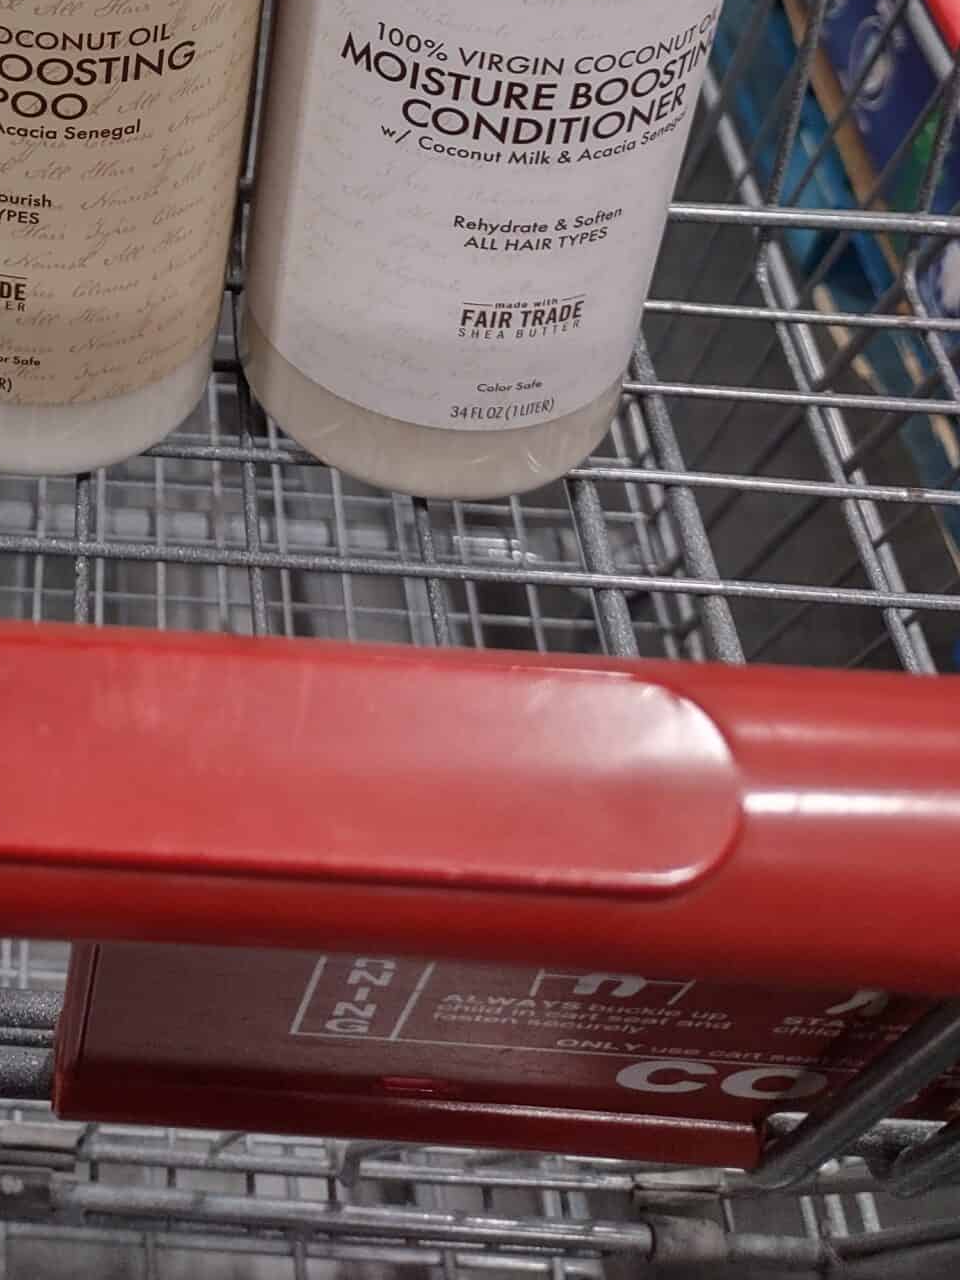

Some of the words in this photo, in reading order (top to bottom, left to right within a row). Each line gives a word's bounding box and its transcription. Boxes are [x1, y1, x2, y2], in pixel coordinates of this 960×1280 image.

[128, 23, 171, 47] OIL
[377, 21, 448, 62] 100%
[458, 47, 565, 76] VIRGIN
[574, 24, 697, 74] COCONUT
[340, 31, 557, 111] MOISTURE
[569, 30, 713, 111] BOOSTIN
[401, 83, 687, 146] CONDITIONER
[63, 118, 141, 141] Senegal
[381, 125, 411, 144] w/
[418, 135, 502, 163] Coconut
[507, 147, 550, 166] Milk
[556, 149, 571, 164] &
[576, 139, 636, 163] Acacia
[453, 215, 548, 236] Rehydrate
[554, 218, 567, 232] &
[572, 208, 622, 228] Soften
[463, 236, 498, 251] ALL
[504, 237, 552, 251] HAIR
[558, 226, 608, 249] TYPES
[460, 308, 513, 330] FAIR
[519, 300, 585, 328] TRADE
[494, 300, 528, 309] made
[533, 298, 559, 308] with
[457, 327, 506, 340] SHEA
[515, 319, 581, 339] BUTTER
[13, 354, 41, 367] Safe
[476, 382, 513, 393] Color
[515, 379, 543, 391] Safe
[450, 405, 468, 418] 34
[470, 405, 484, 419] FL
[486, 404, 504, 419] OZ
[441, 993, 583, 1011] ALWAYS
[555, 1037, 646, 1052] ONLY
